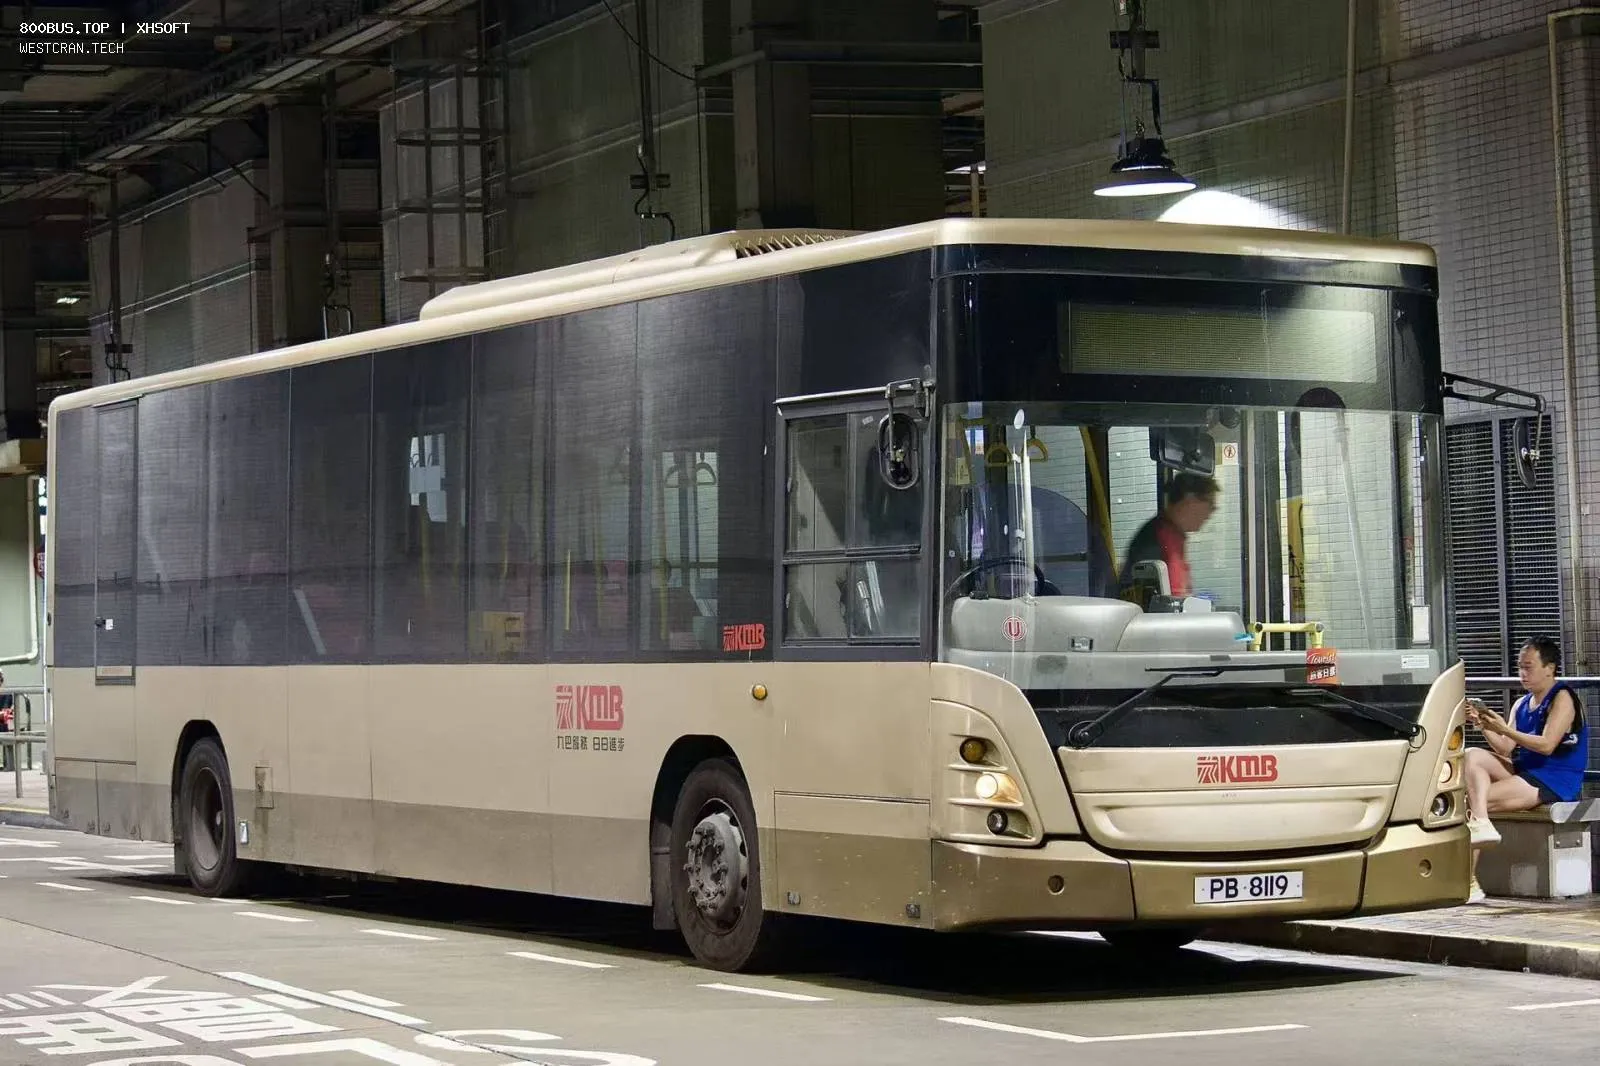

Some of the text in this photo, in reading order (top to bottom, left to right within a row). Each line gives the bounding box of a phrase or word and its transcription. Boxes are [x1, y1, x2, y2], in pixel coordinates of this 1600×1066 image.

[735, 623, 765, 651] KMB
[576, 685, 624, 731] KMB
[1220, 754, 1279, 784] KMB
[1210, 874, 1289, 900] PB 8119
